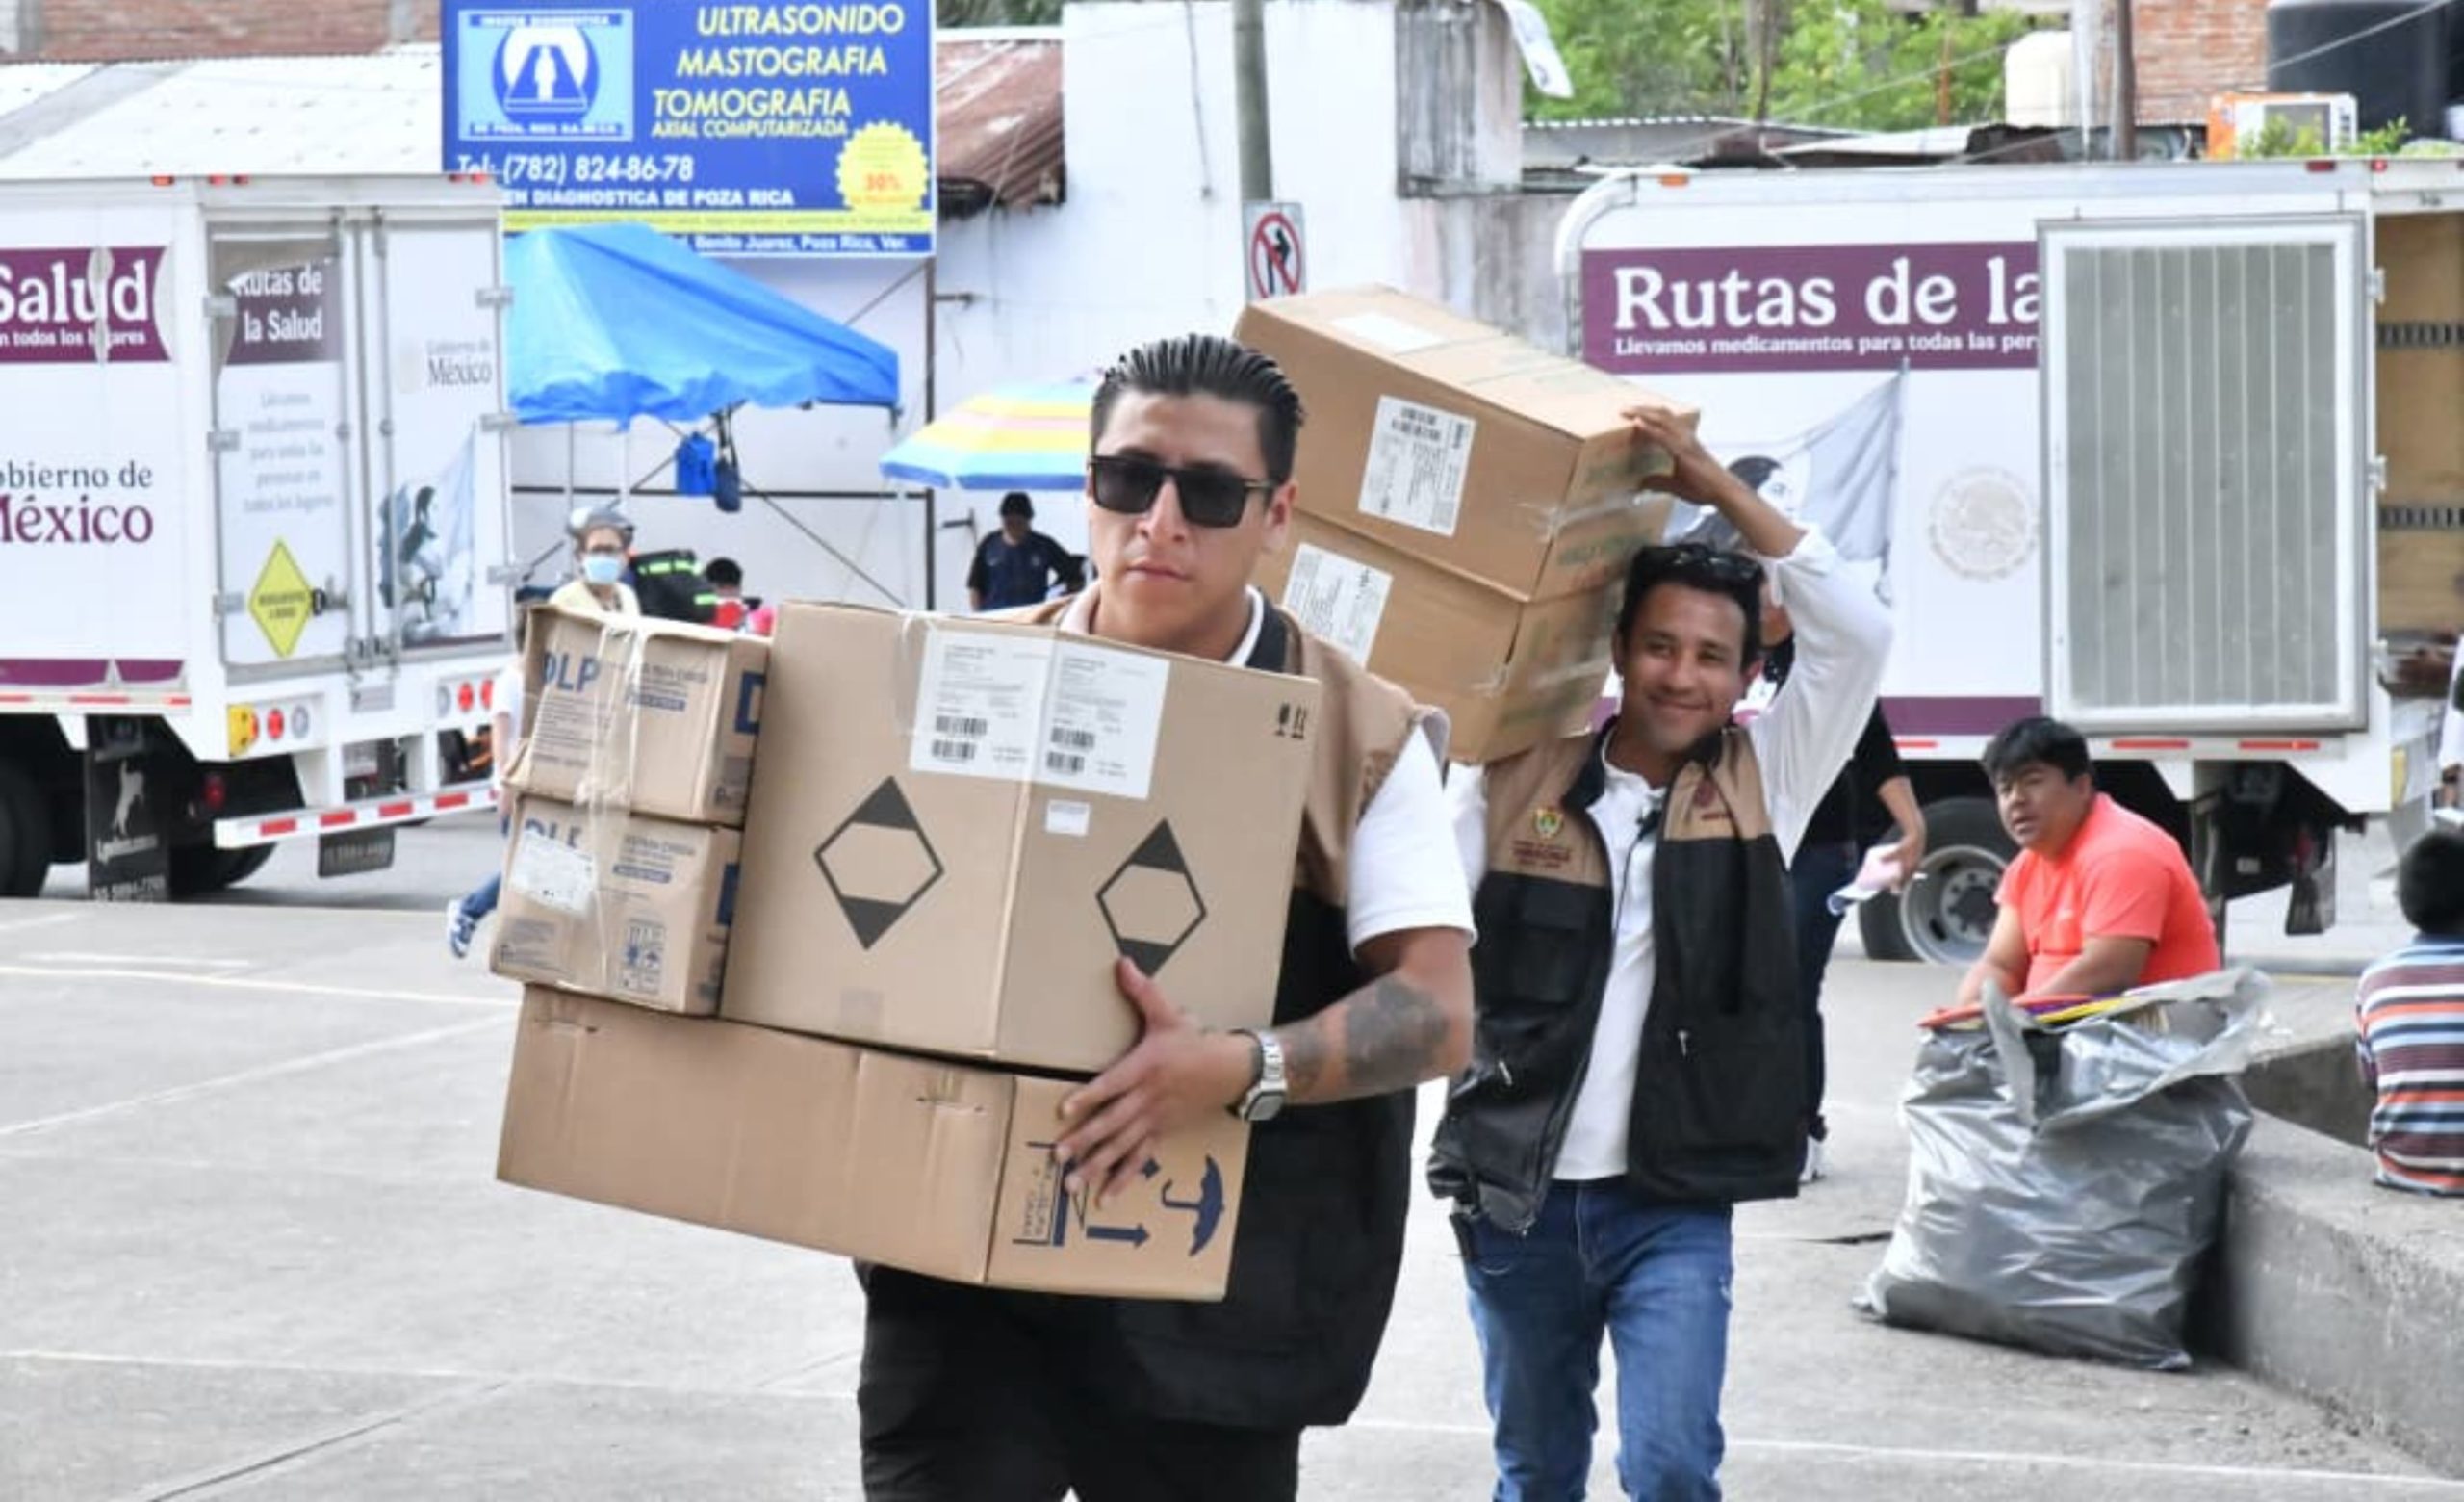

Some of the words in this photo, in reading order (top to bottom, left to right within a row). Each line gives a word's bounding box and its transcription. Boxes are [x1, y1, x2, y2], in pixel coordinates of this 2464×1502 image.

[697, 4, 905, 35] ULTRASONIDO
[677, 45, 886, 77] MASTOGRAFIA
[652, 88, 851, 117] TOMOGRAFIA
[652, 118, 699, 138] AXIAL
[703, 118, 848, 138] COMPUTARIZADA
[502, 154, 567, 184] (782)
[574, 154, 694, 181] 824-86-78
[532, 190, 658, 206] DIAGNOSTICA
[663, 190, 689, 206] DE
[694, 190, 744, 206] POZA
[749, 190, 795, 206] RICA
[0, 259, 148, 324] Salud
[297, 263, 324, 295] de
[1613, 266, 1837, 329] Rutas
[1864, 256, 1958, 325] de
[1986, 256, 2039, 324] la
[13, 327, 56, 347] todos
[60, 326, 84, 347] los
[88, 326, 146, 349] lares
[244, 309, 263, 343] la
[267, 305, 323, 341] Salud
[1615, 335, 1707, 356] Llevamos
[1711, 334, 1854, 354] medicamentos
[1859, 335, 1903, 355] para
[1909, 331, 1963, 351] todas
[1968, 331, 1996, 350] las
[119, 460, 154, 489] de
